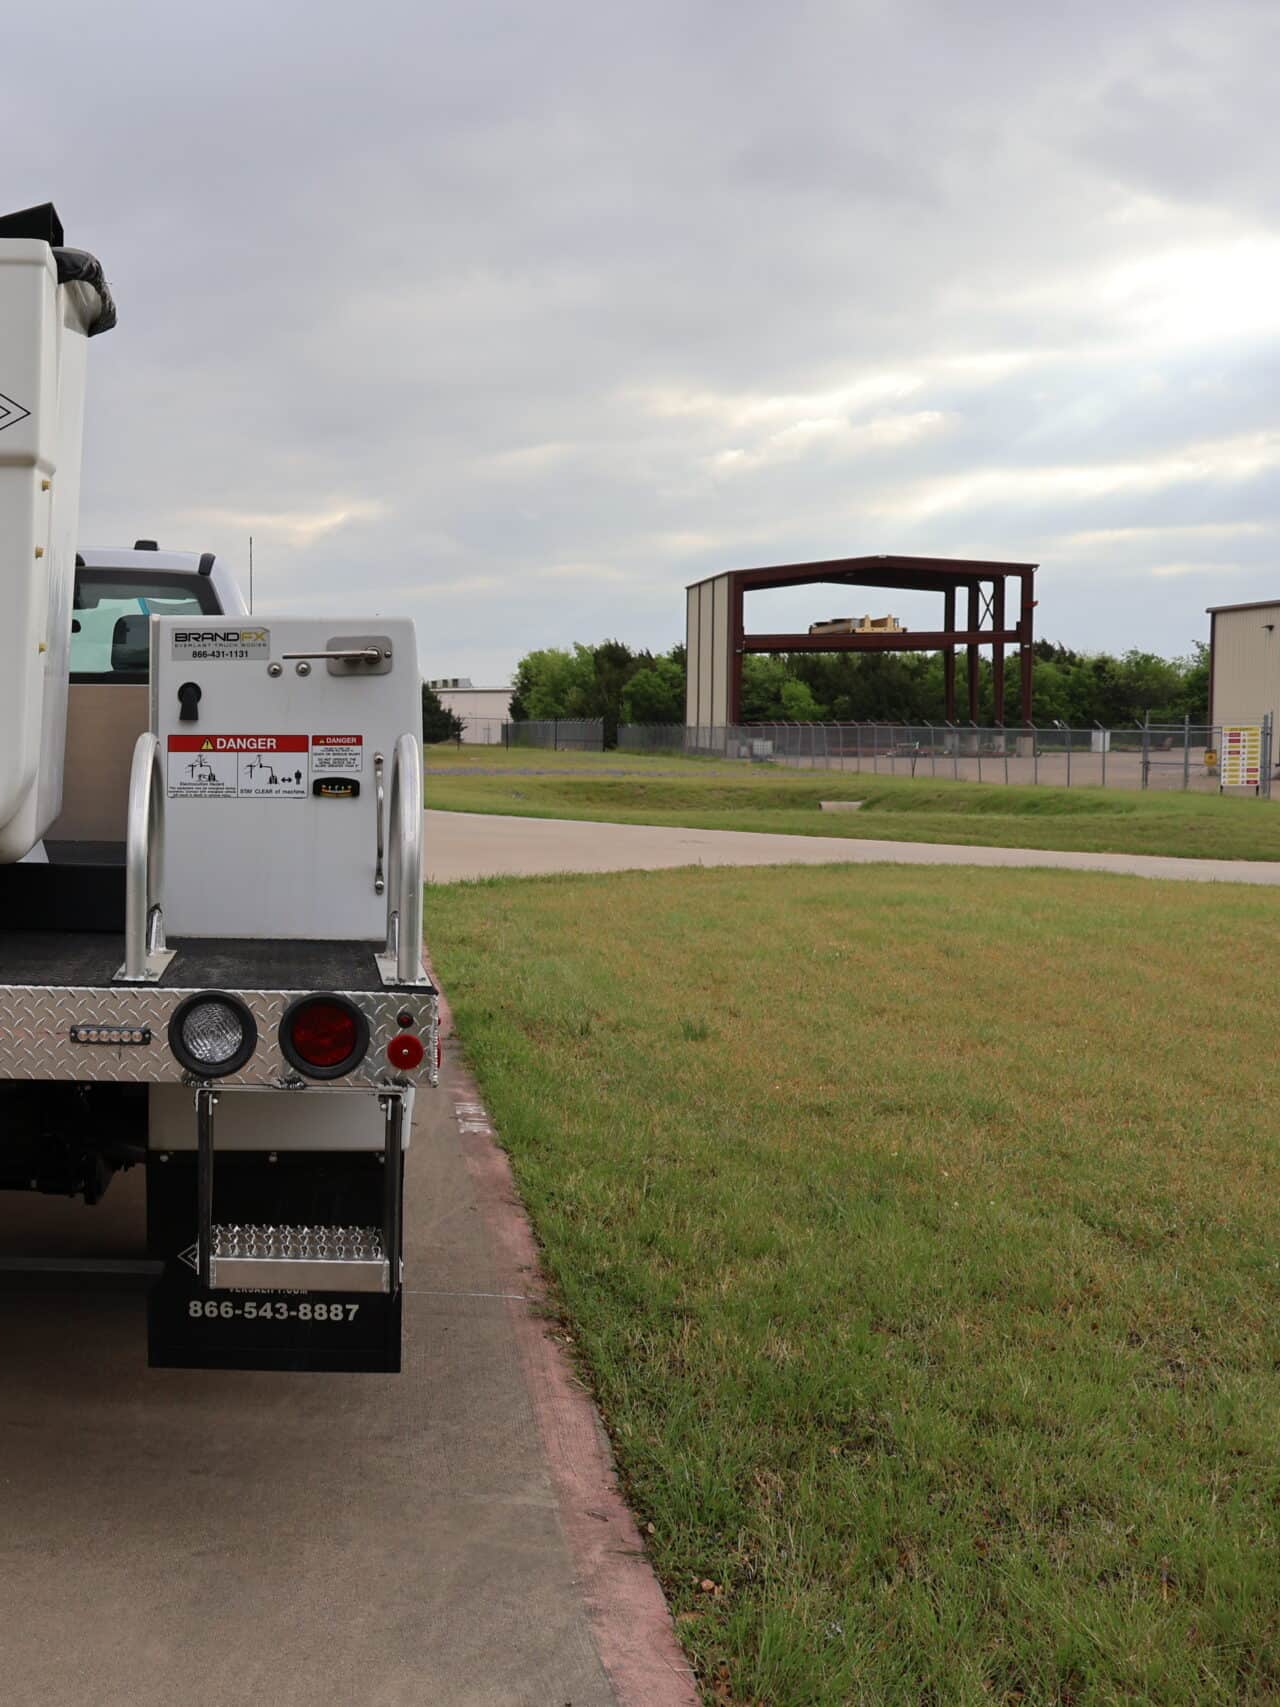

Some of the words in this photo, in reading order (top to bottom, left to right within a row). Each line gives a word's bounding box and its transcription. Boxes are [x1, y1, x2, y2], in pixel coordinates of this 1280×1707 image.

[192, 650, 249, 659] 866-431-1131
[216, 737, 277, 750] DANGER
[326, 736, 357, 745] DANGER
[188, 1300, 360, 1321] 866-543-8887
